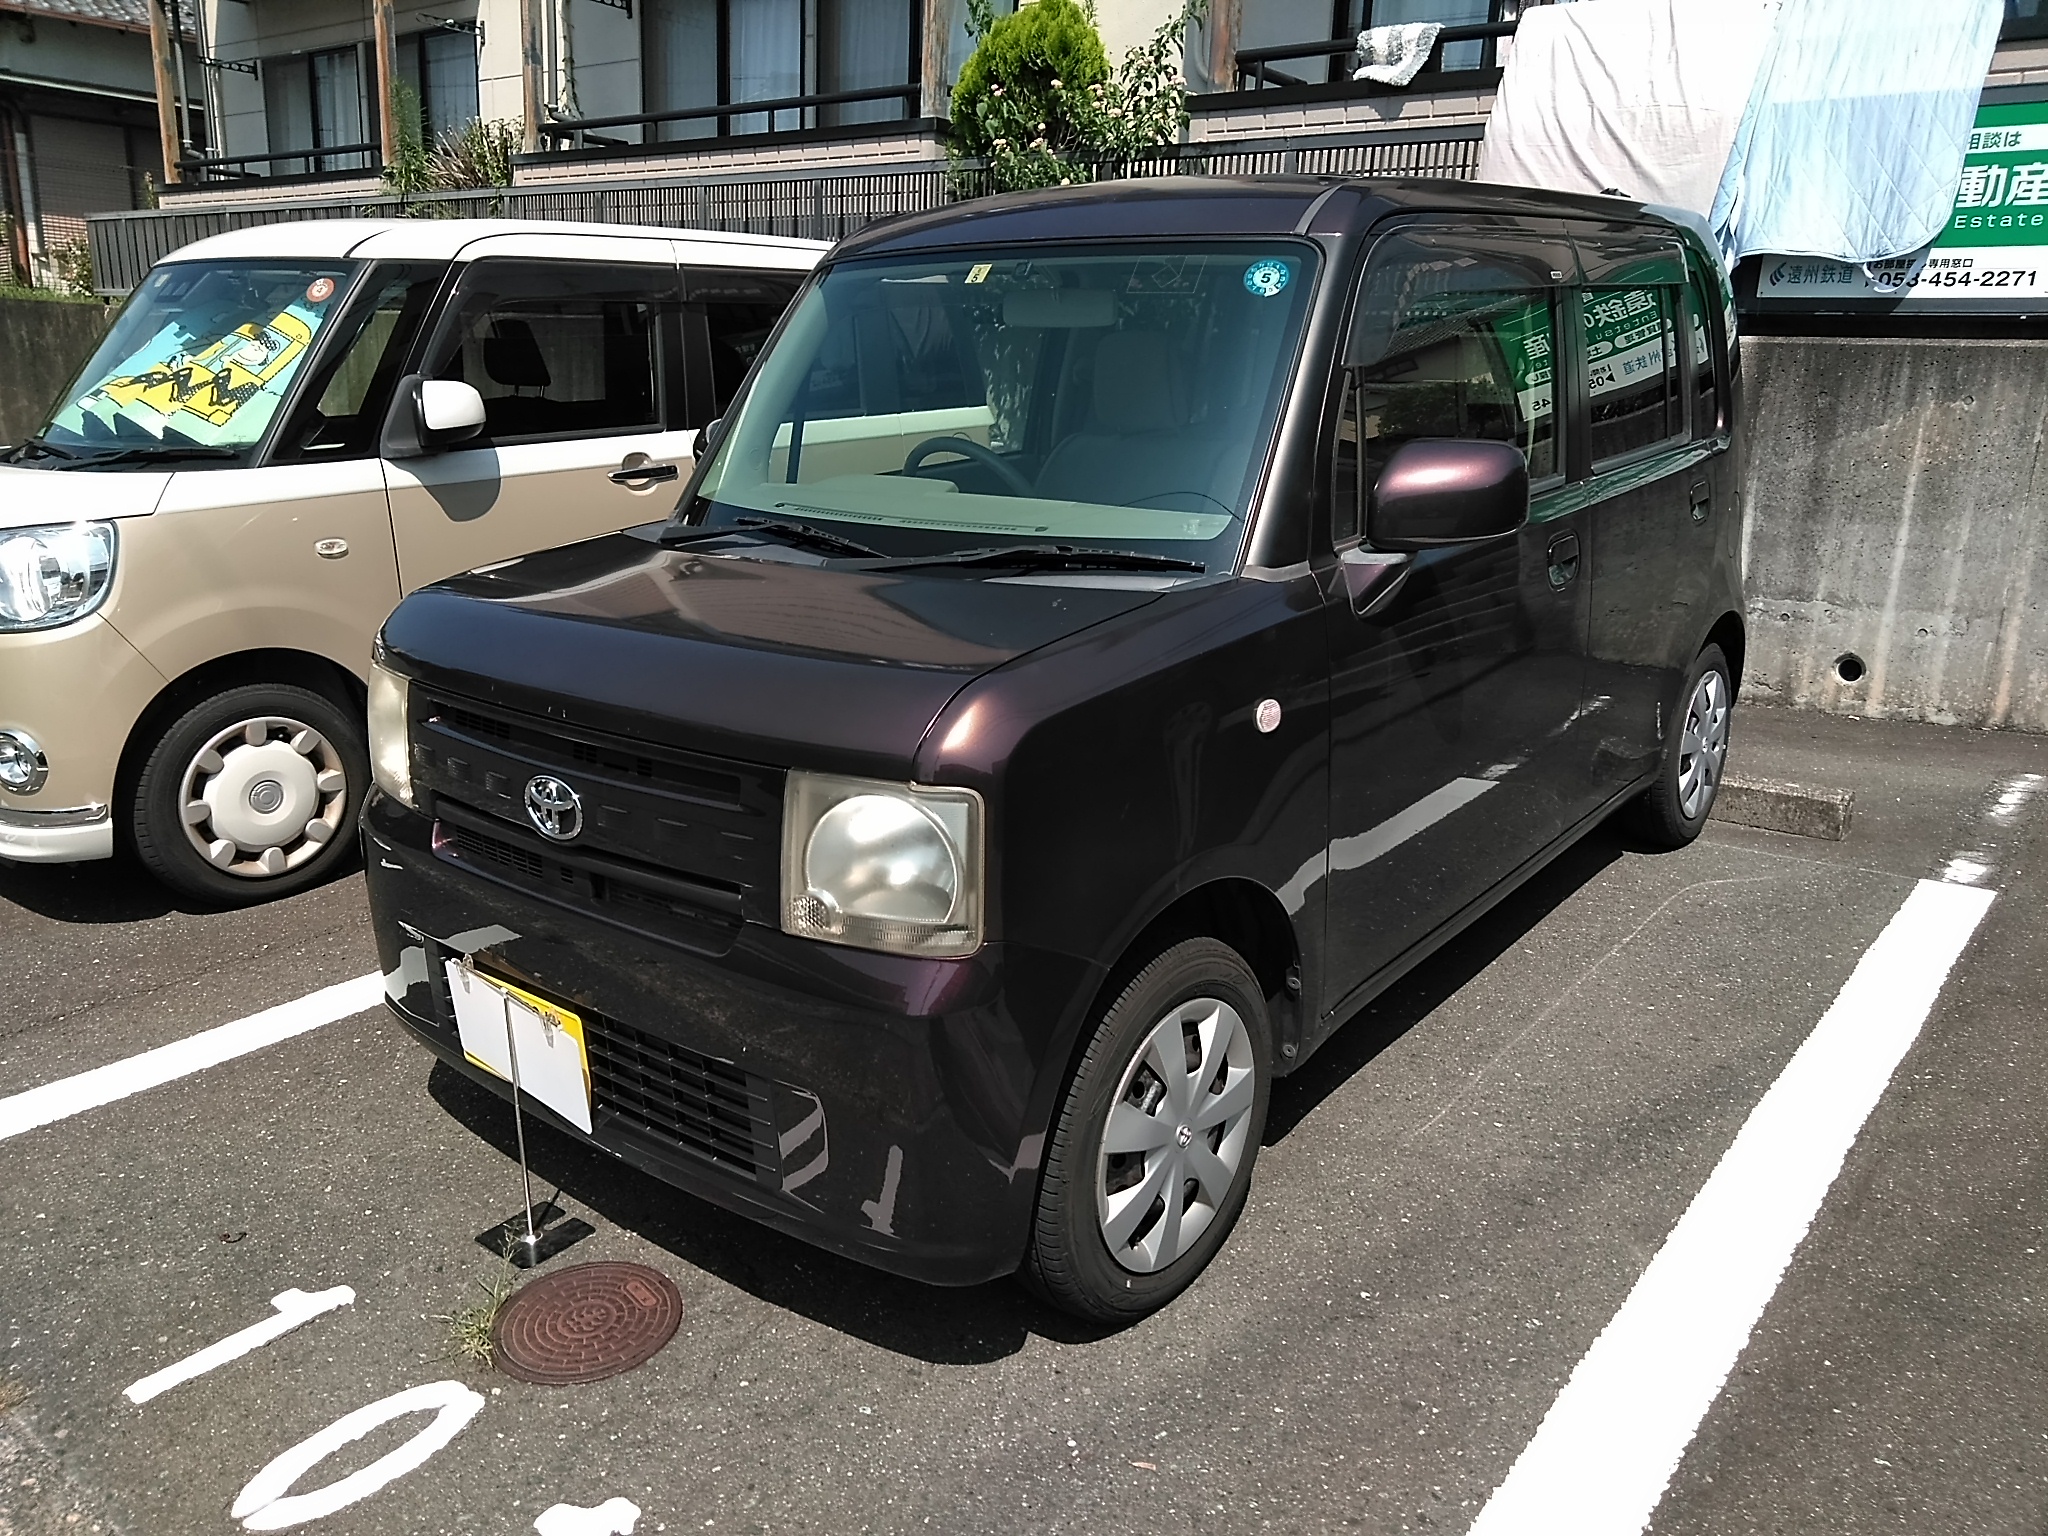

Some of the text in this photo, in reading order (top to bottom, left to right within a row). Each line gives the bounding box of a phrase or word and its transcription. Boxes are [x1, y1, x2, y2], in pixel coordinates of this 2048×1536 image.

[1954, 213, 2044, 229] Estate
[1261, 273, 1271, 284] 5
[1787, 264, 1855, 284] 遠州鉄道
[1878, 271, 2037, 288] 053-454-2271
